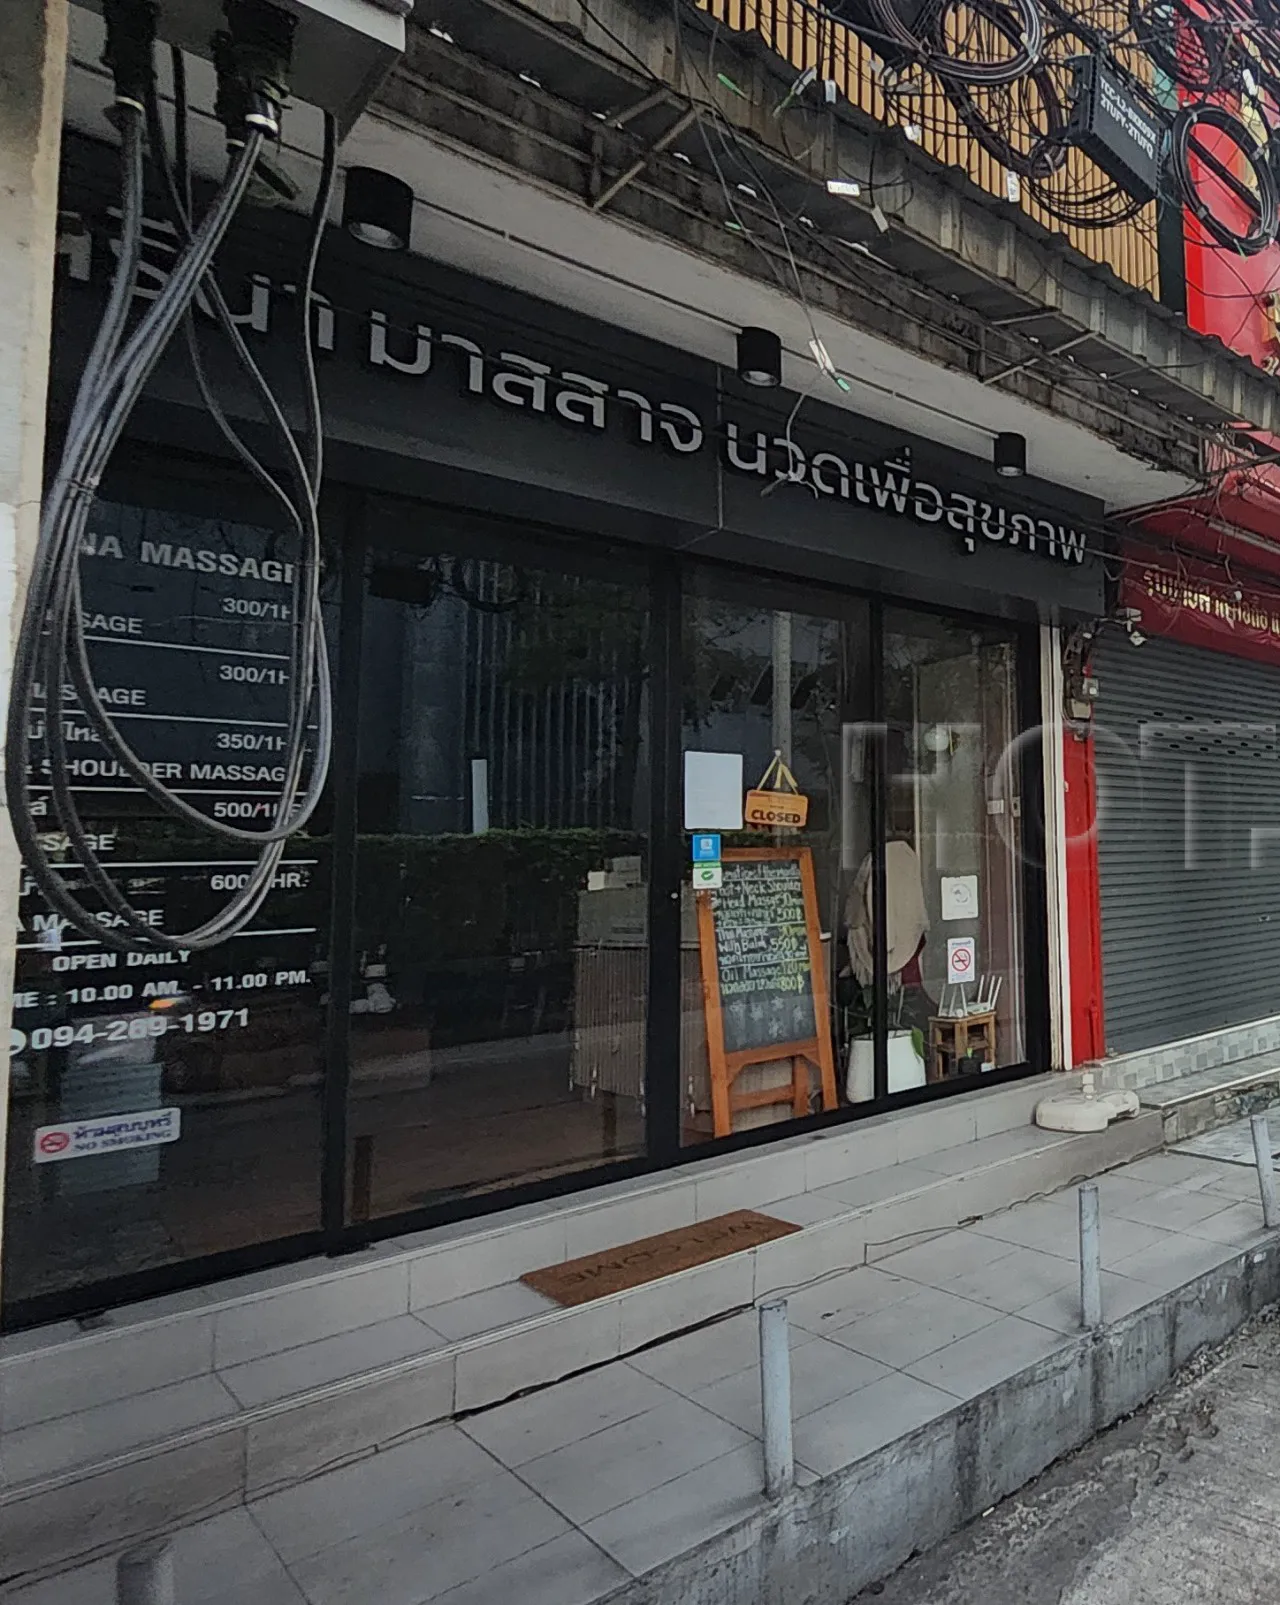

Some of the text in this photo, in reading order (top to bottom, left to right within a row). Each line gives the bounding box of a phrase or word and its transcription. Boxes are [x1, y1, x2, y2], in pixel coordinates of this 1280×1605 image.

[727, 422, 1086, 564] นวดเพื่อสุขภาพ
[190, 764, 286, 782] MASSAG
[751, 809, 801, 824] CLOSED
[52, 950, 192, 972] OPEN DAILY
[66, 984, 134, 1005] 10.00
[211, 972, 268, 992] 11.00
[275, 969, 311, 986] PM.
